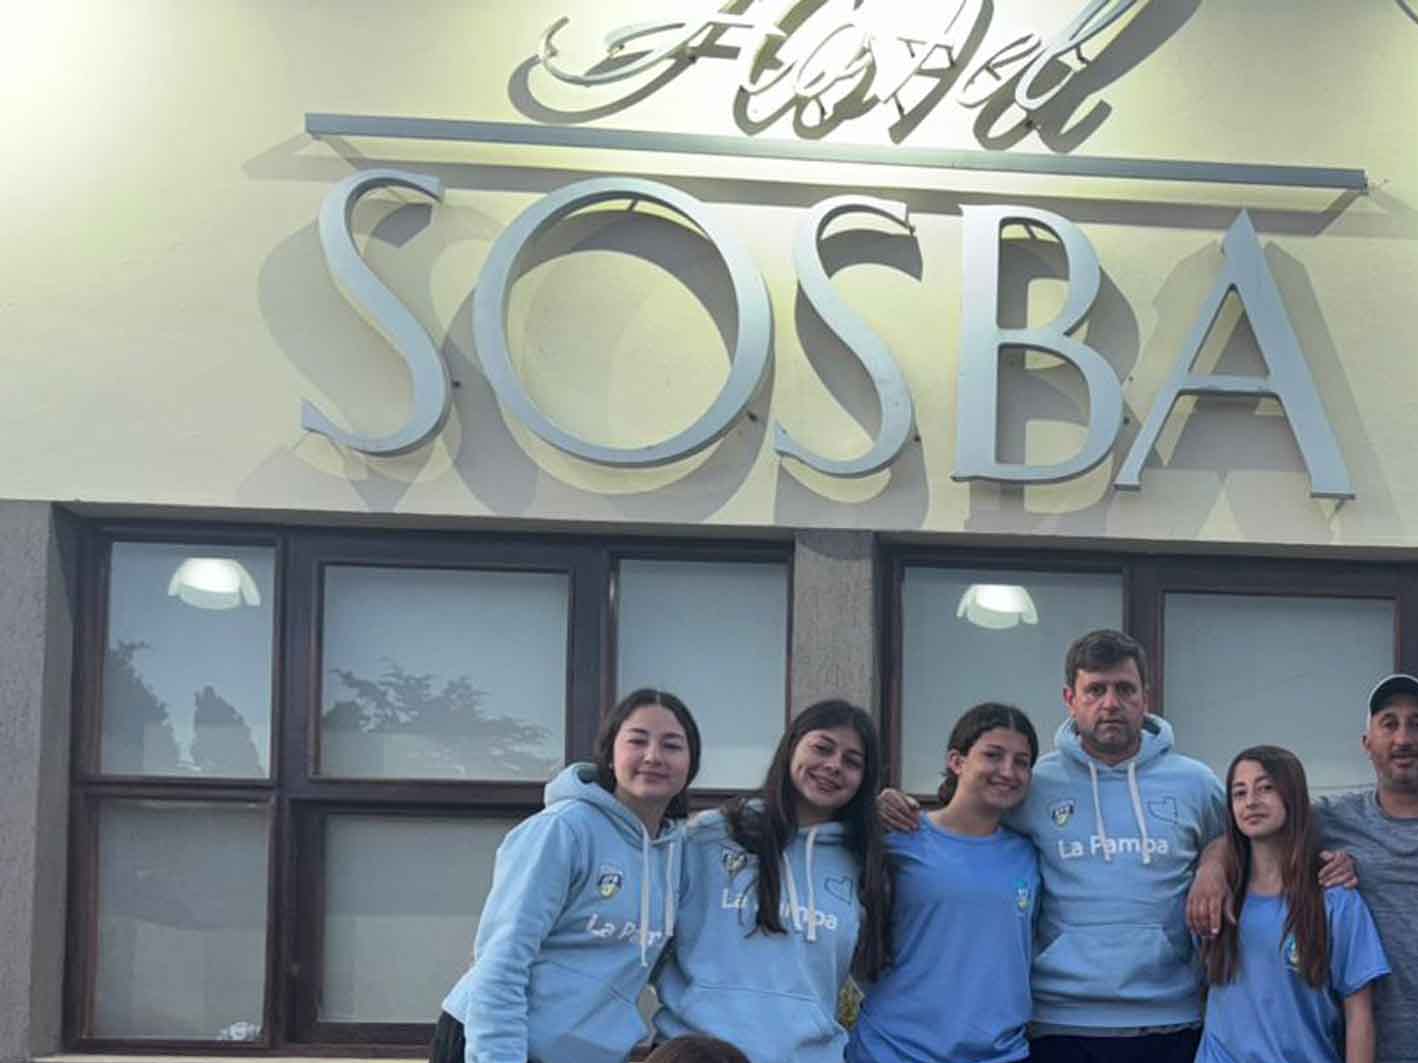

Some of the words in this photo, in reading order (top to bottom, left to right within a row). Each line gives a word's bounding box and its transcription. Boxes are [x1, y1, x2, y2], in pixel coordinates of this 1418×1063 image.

[301, 170, 1357, 500] SOSBA
[1058, 839, 1083, 858] La
[586, 912, 616, 938] La
